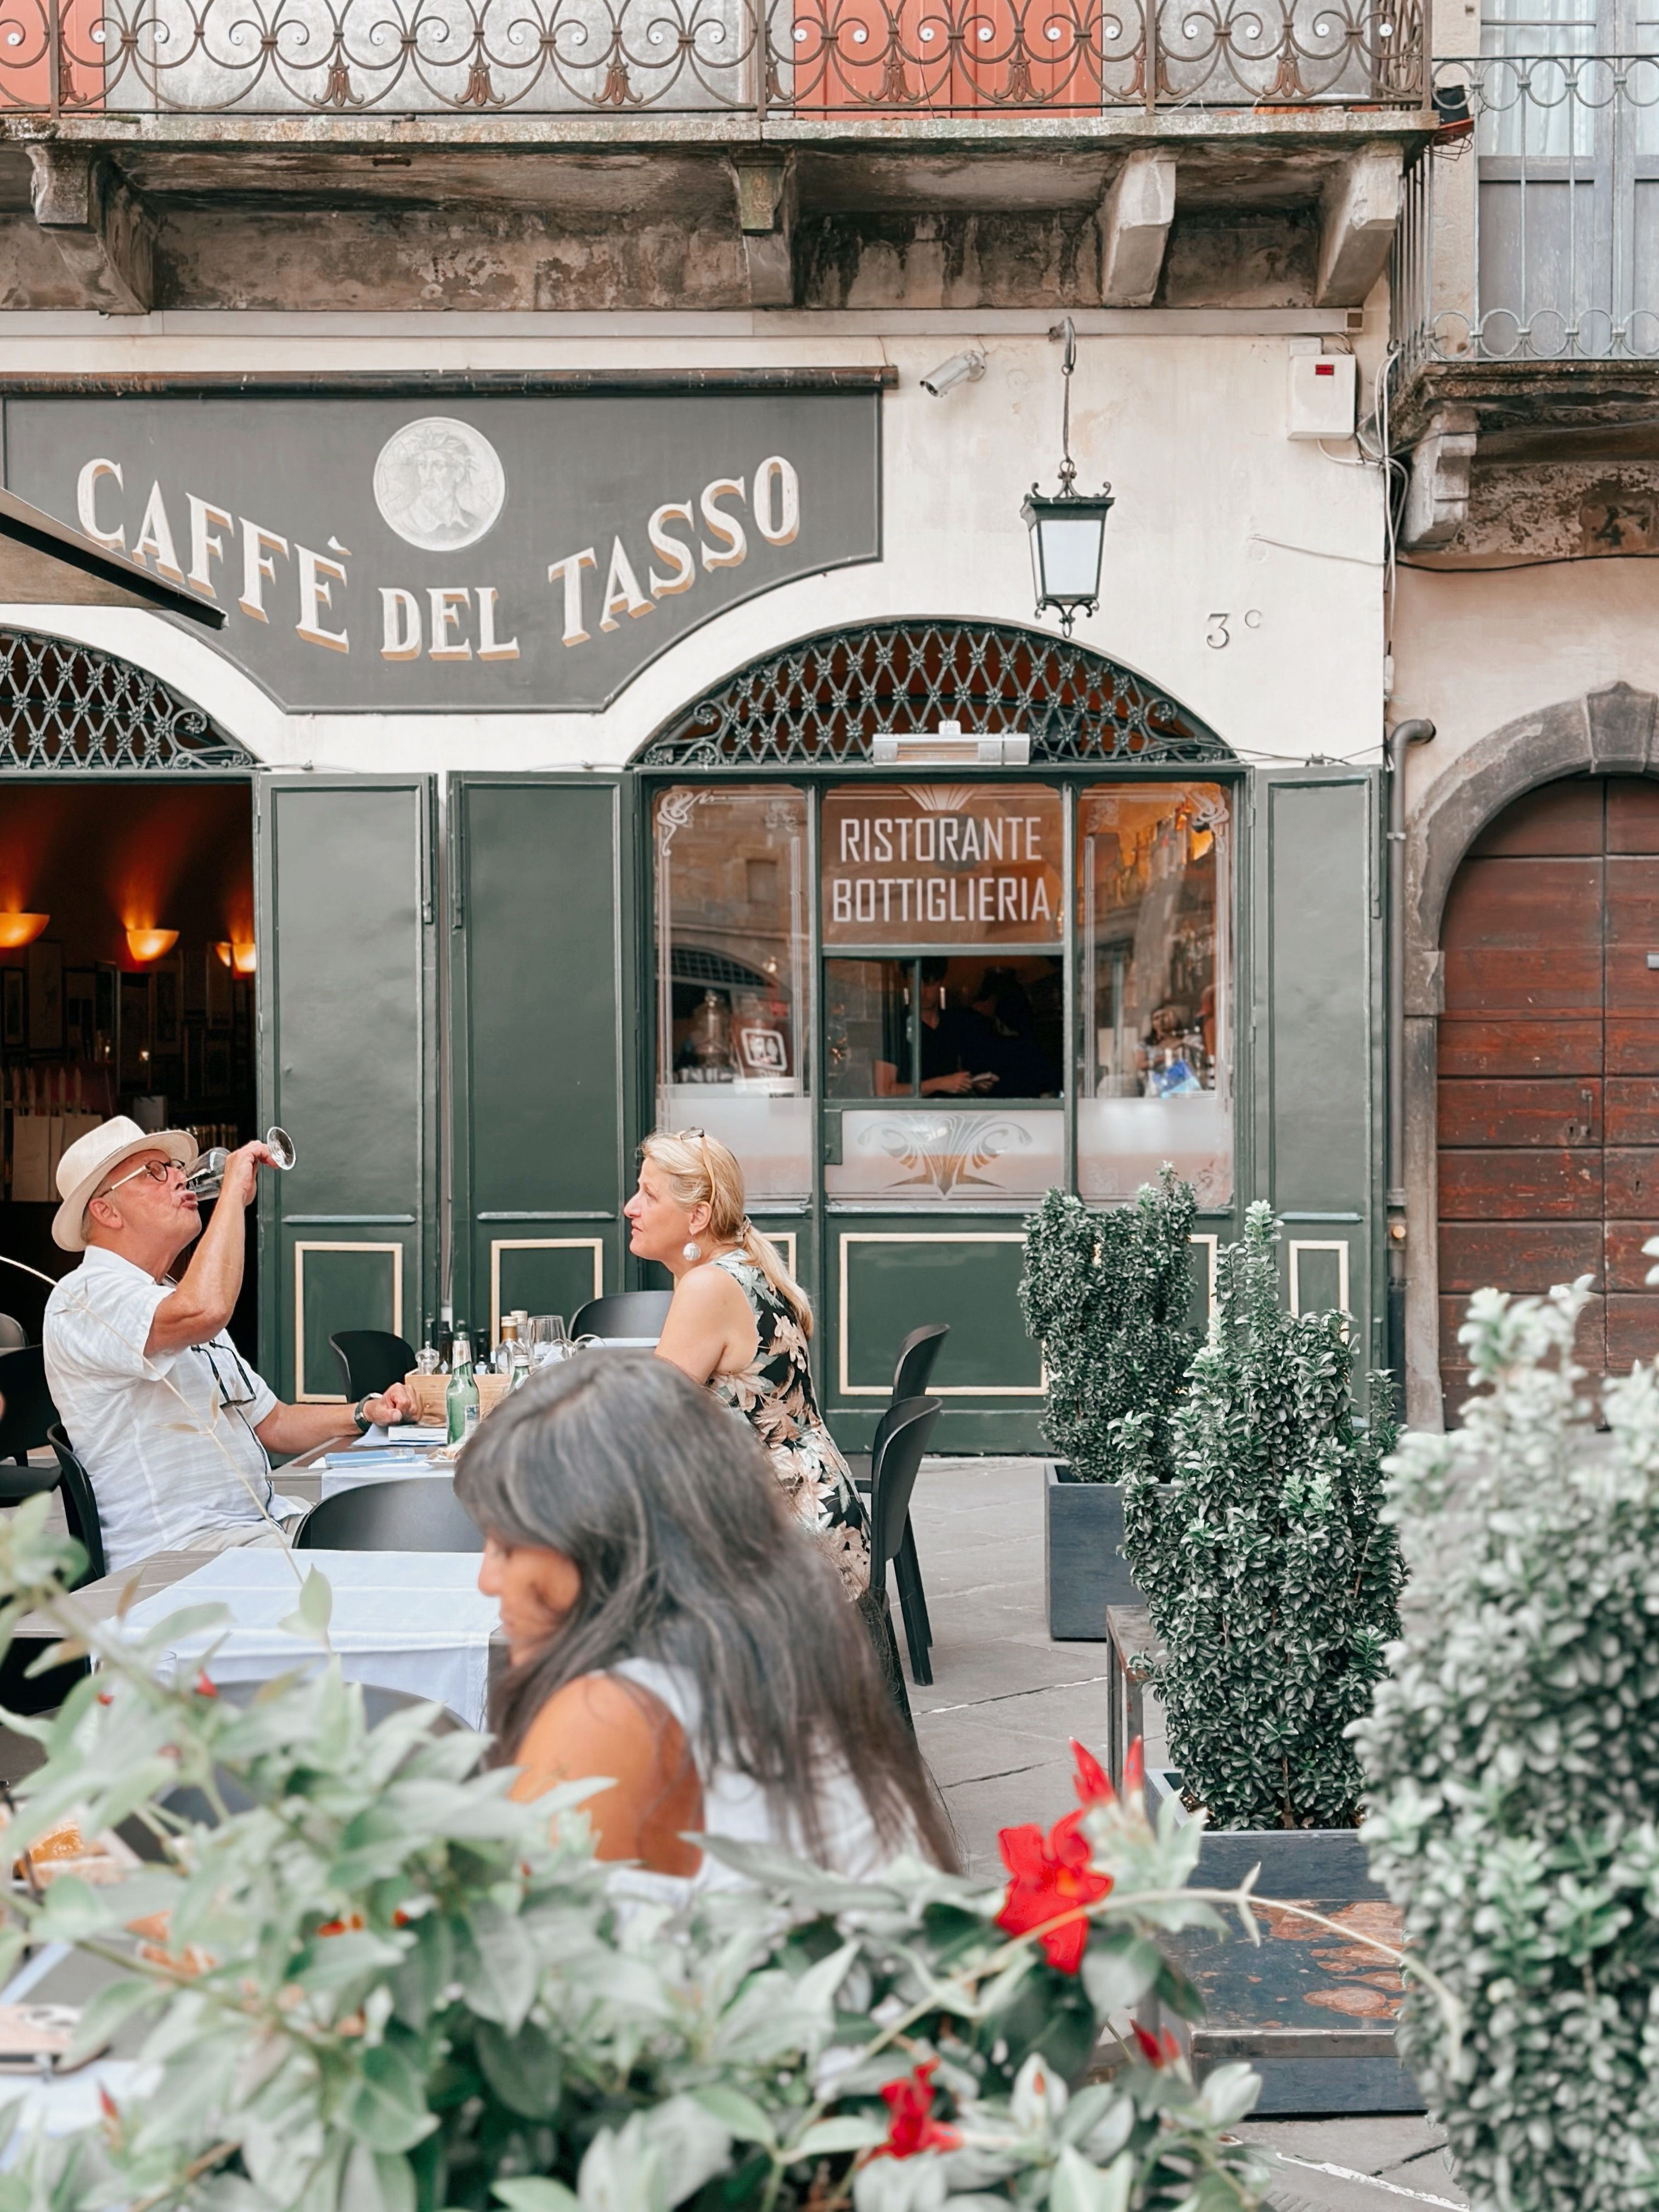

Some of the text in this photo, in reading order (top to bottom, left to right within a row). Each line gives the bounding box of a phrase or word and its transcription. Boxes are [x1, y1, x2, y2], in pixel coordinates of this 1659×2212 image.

[76, 455, 800, 662] CAFFÈ DEL TASSO
[840, 817, 1042, 862] RISTORANTE
[832, 877, 1052, 922] BOTTIGLIERIA
